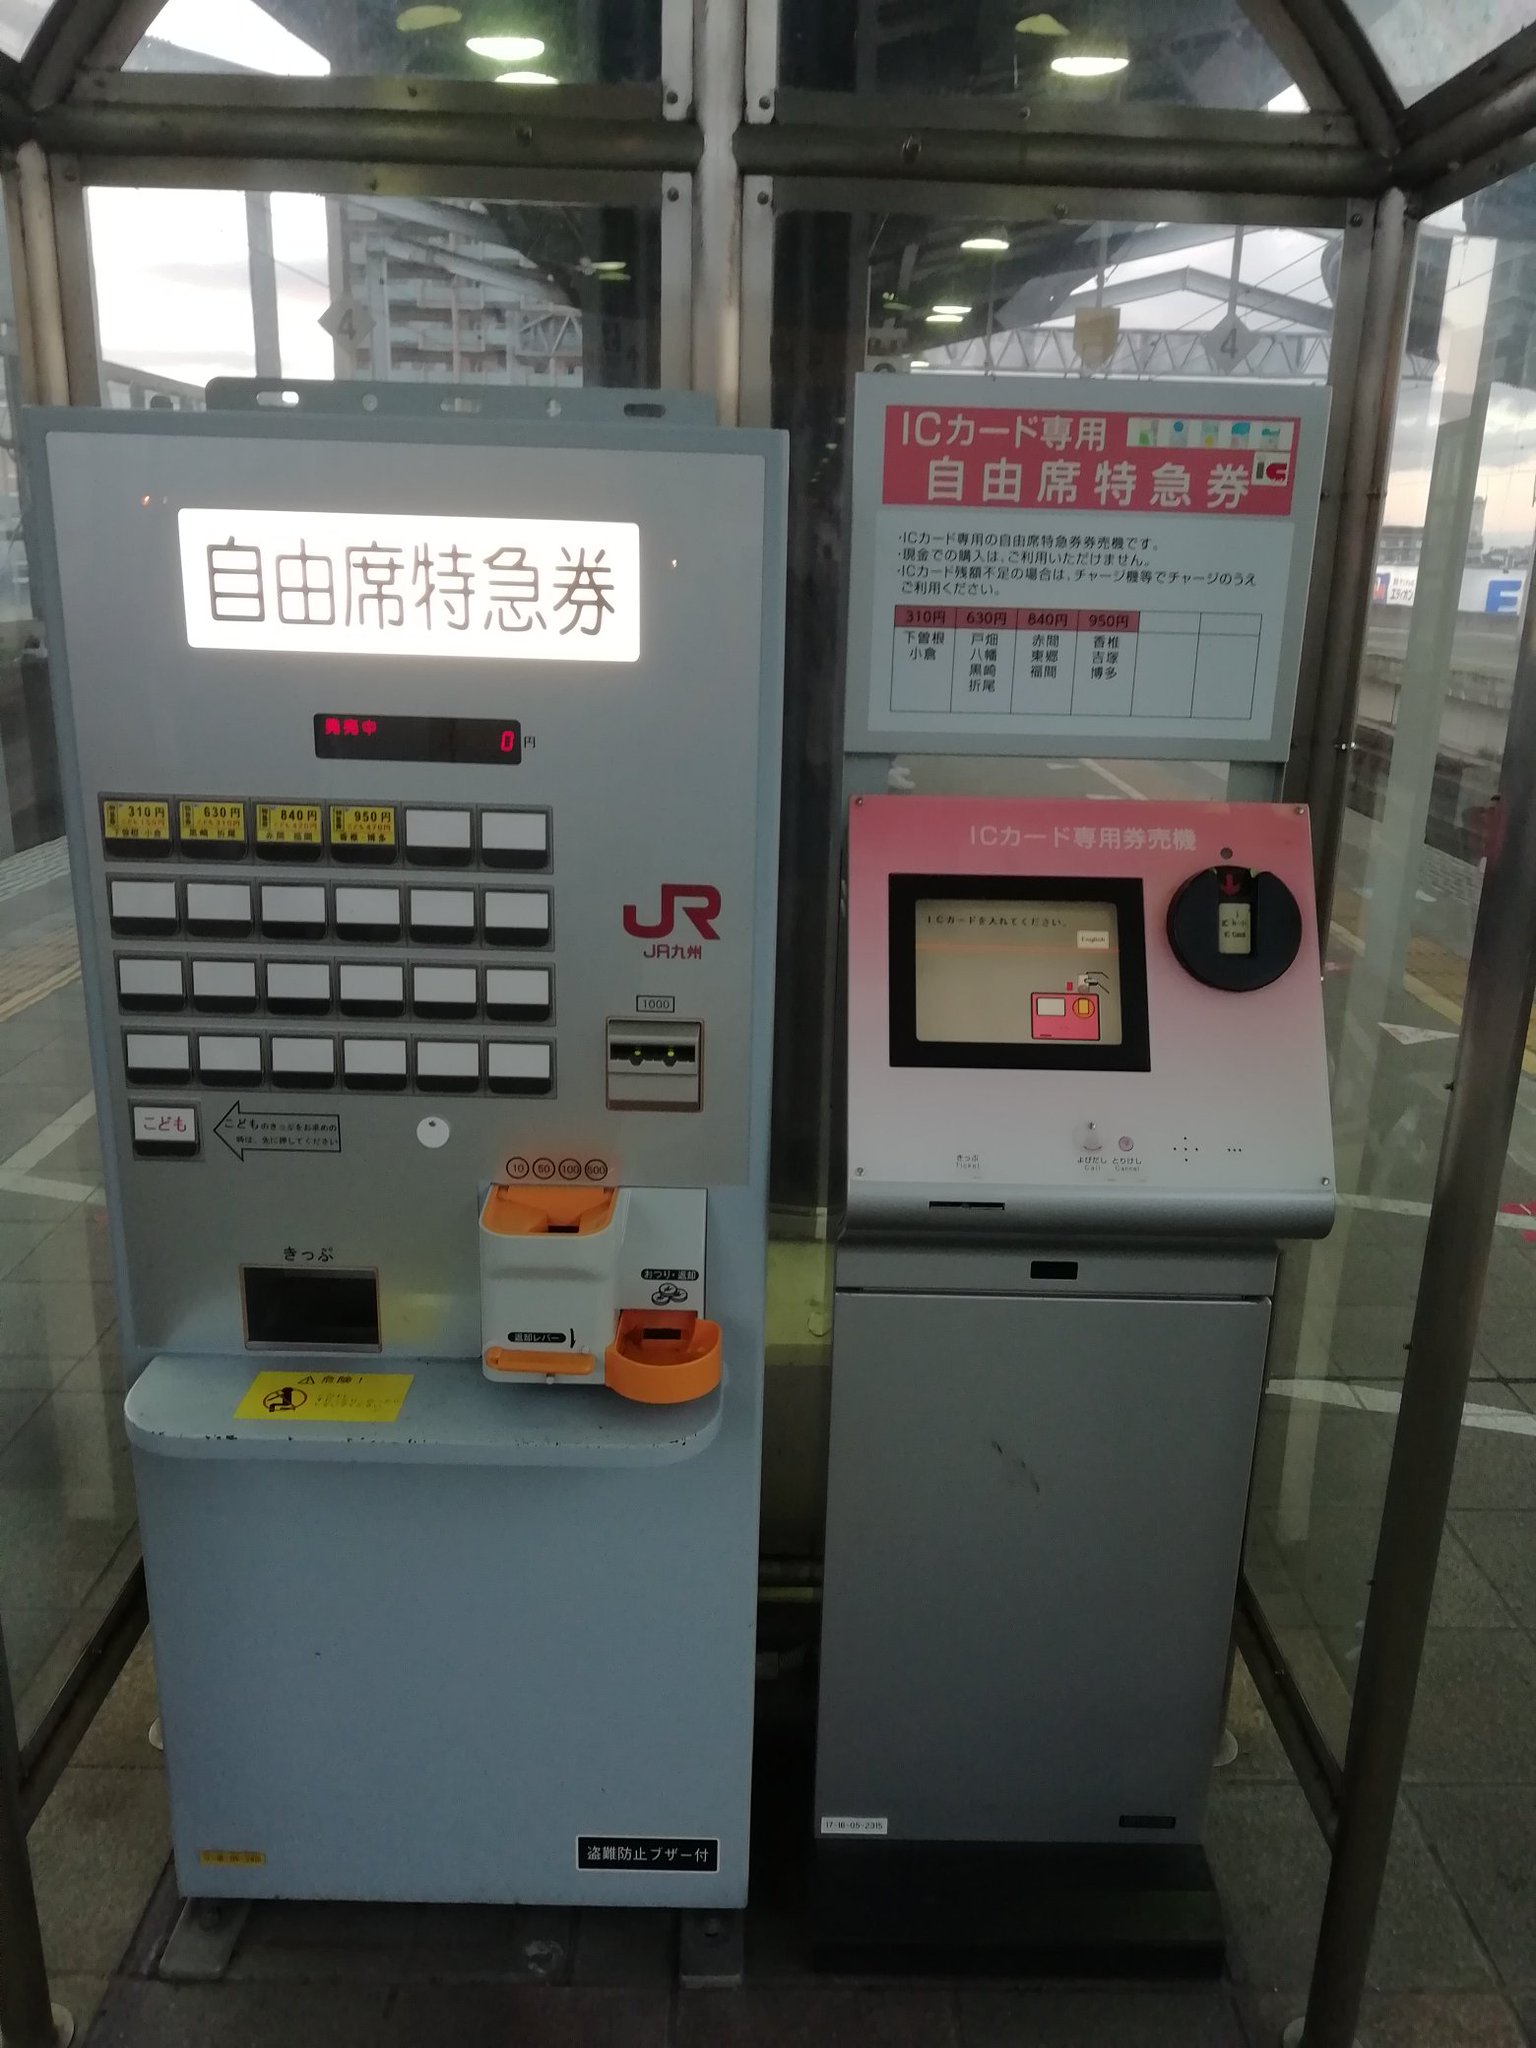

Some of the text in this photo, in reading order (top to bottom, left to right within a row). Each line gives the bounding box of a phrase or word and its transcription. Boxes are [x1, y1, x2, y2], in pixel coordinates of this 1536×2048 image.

[1220, 327, 1237, 359] 4
[902, 412, 1106, 451] ICカード専用
[928, 456, 1250, 509] 自由席特急券
[206, 535, 615, 636] 自由席特急券
[901, 581, 1001, 596] ご利用ください。
[905, 610, 946, 624] 310円
[966, 611, 1007, 626] 630円
[1028, 613, 1068, 627] 840円
[1088, 614, 1129, 629] 950円
[971, 632, 999, 646] 戸畑
[1032, 634, 1060, 648] 赤間
[1093, 635, 1120, 649] 香椎
[909, 647, 937, 661] 小倉
[970, 648, 998, 662] 八幡
[969, 664, 997, 677] 黒崎
[1030, 665, 1058, 679] 福間
[1091, 666, 1118, 680] 博多
[968, 679, 996, 693] 折尾
[523, 735, 536, 749] 円
[127, 805, 166, 819] 310円
[203, 806, 241, 819] 630円
[280, 809, 317, 822] 840円
[354, 811, 391, 823] 950円
[969, 825, 1197, 852] ICカード専用券売機
[622, 883, 722, 941] JR
[643, 943, 702, 960] JR九州
[643, 999, 670, 1010] 1000
[143, 1115, 187, 1132] こども
[956, 1153, 979, 1162] きっぷ
[1077, 1155, 1108, 1165] よびだし
[1112, 1156, 1142, 1165] とりけし
[512, 1163, 524, 1174] 10
[538, 1164, 551, 1174] 50
[561, 1165, 580, 1175] 100
[587, 1165, 605, 1176] 500
[283, 1246, 334, 1262] きっぷ
[587, 1845, 709, 1863] 盗難防止ブザー付
